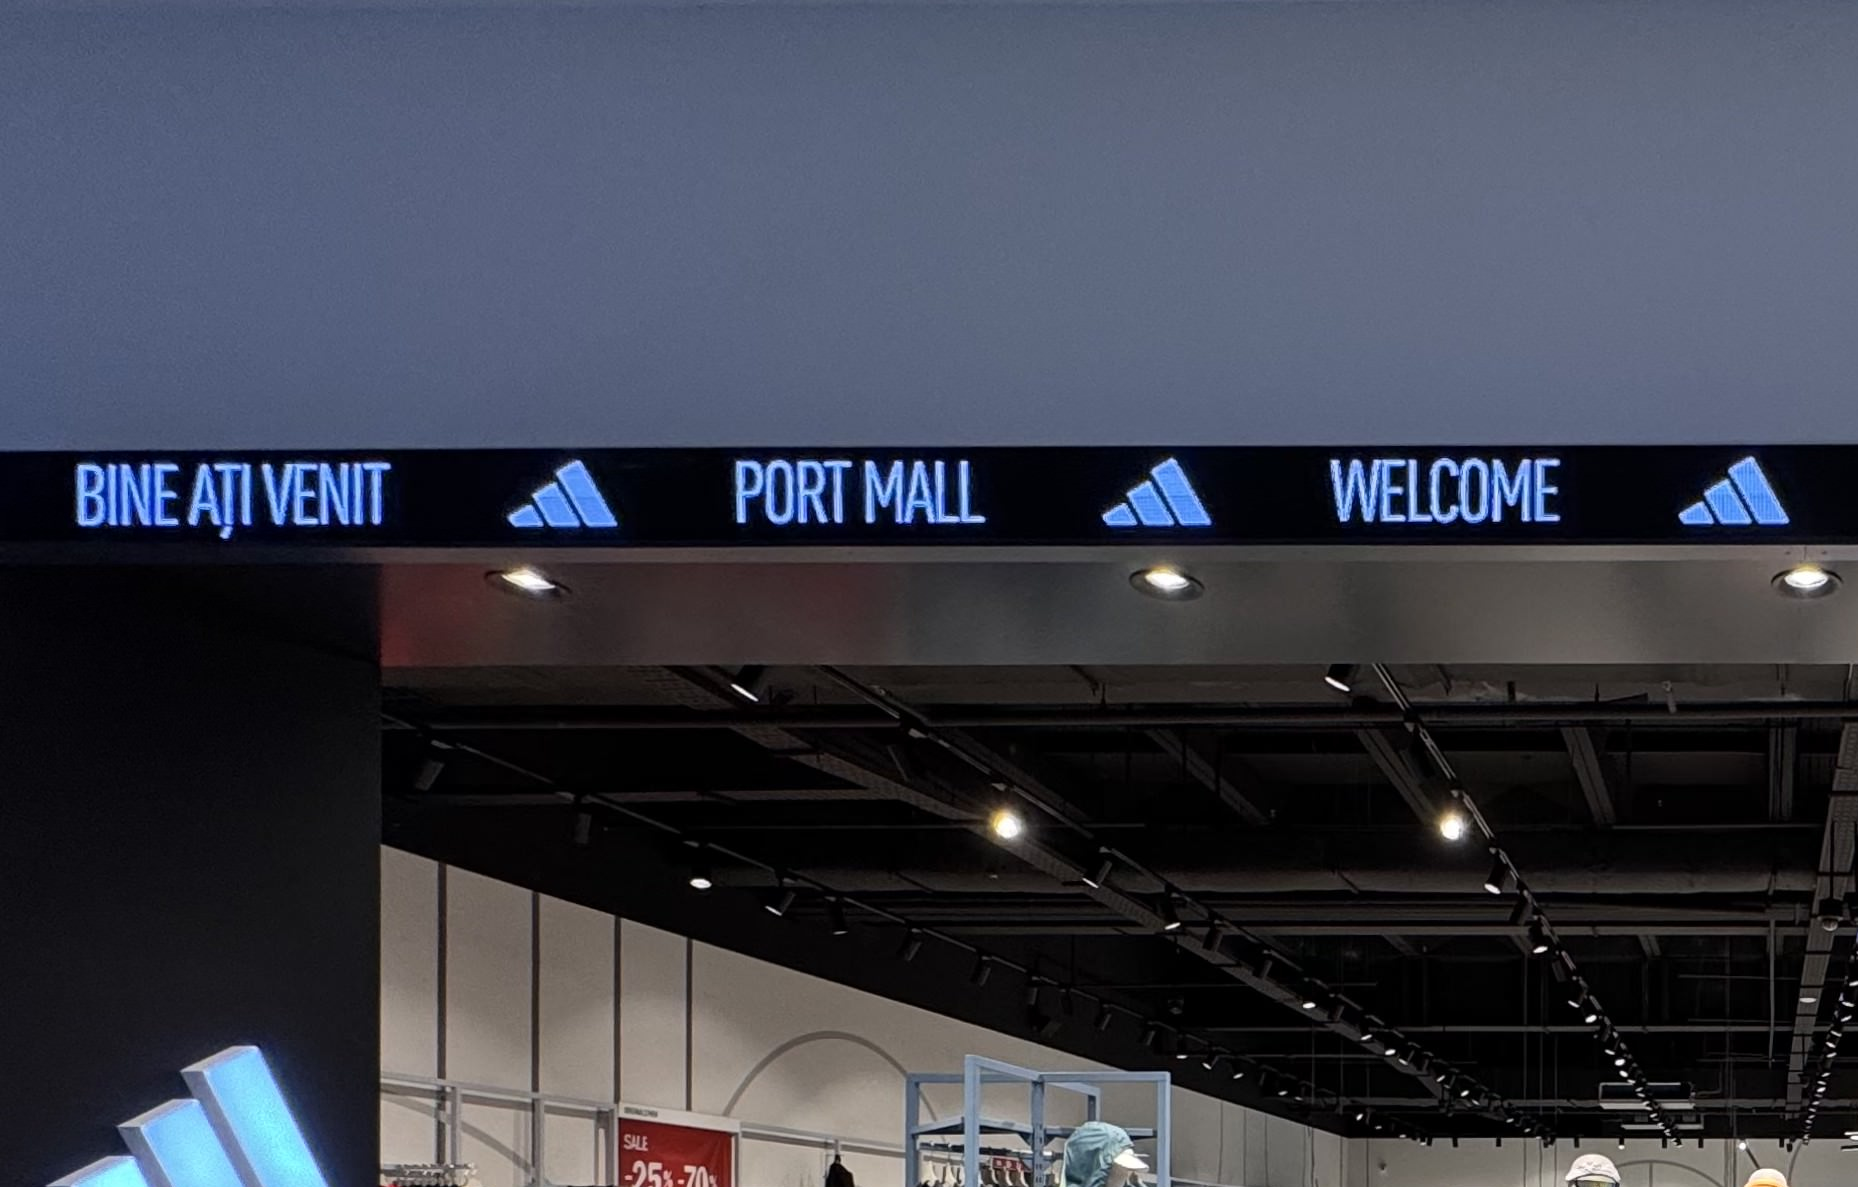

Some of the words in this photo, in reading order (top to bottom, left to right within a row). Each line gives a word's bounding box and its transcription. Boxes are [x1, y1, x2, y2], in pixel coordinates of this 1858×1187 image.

[76, 463, 179, 526] BINE
[261, 462, 391, 525] VENIT
[735, 459, 852, 525] PORT
[864, 460, 985, 524] MALL
[1330, 457, 1560, 523] WELCOME
[623, 1134, 648, 1151] SALE
